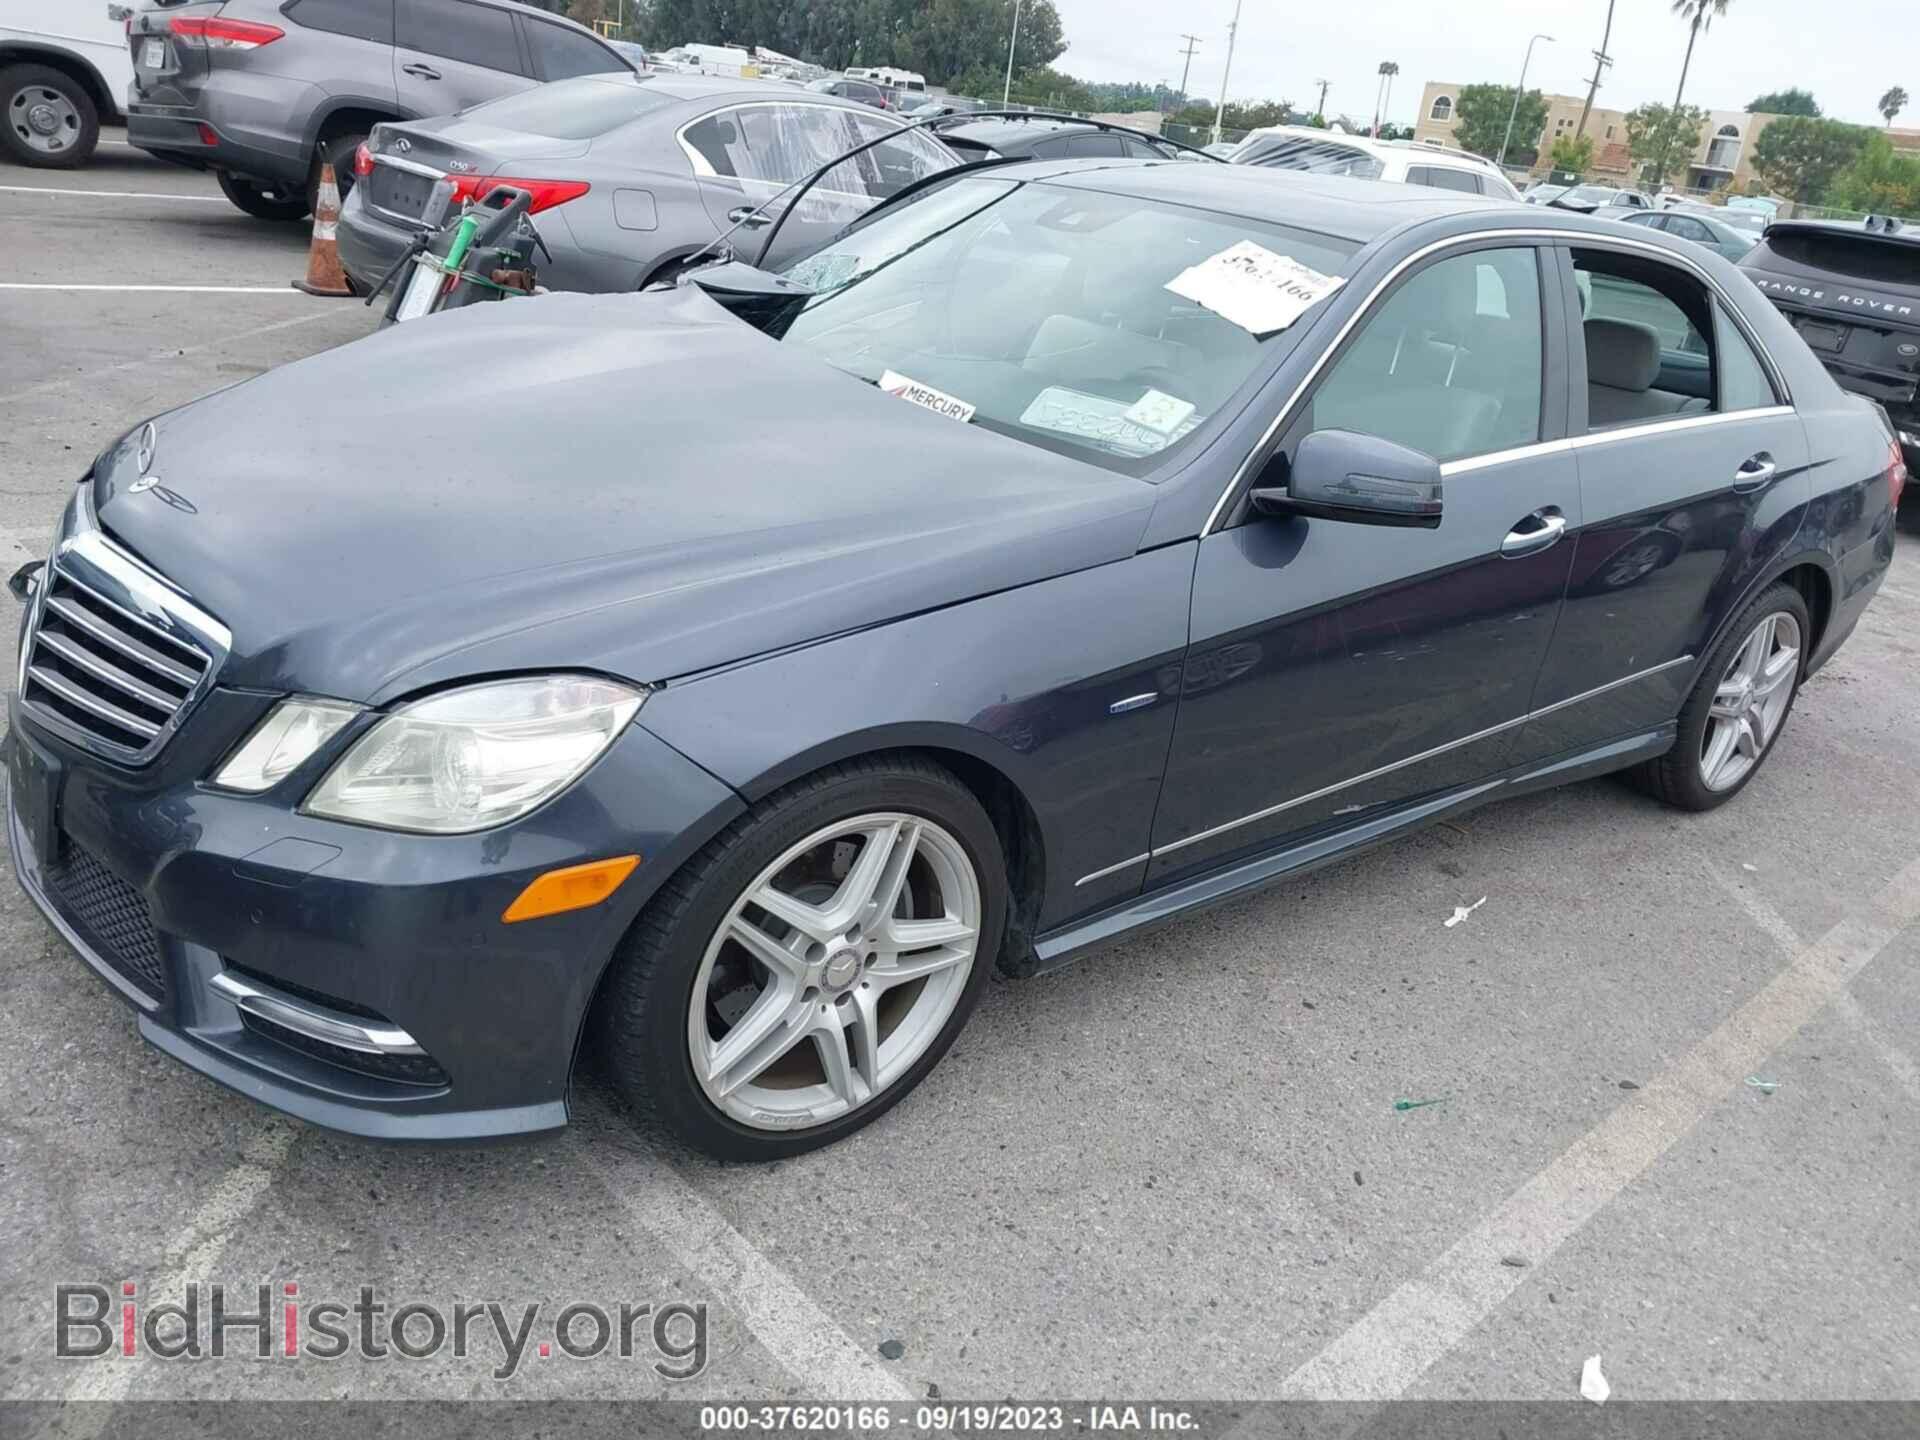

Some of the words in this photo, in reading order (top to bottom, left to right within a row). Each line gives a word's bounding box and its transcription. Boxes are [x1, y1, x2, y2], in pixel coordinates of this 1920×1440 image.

[1756, 279, 1825, 299] RANGE
[1837, 294, 1912, 315] ROVER
[905, 385, 970, 418] MERCURY
